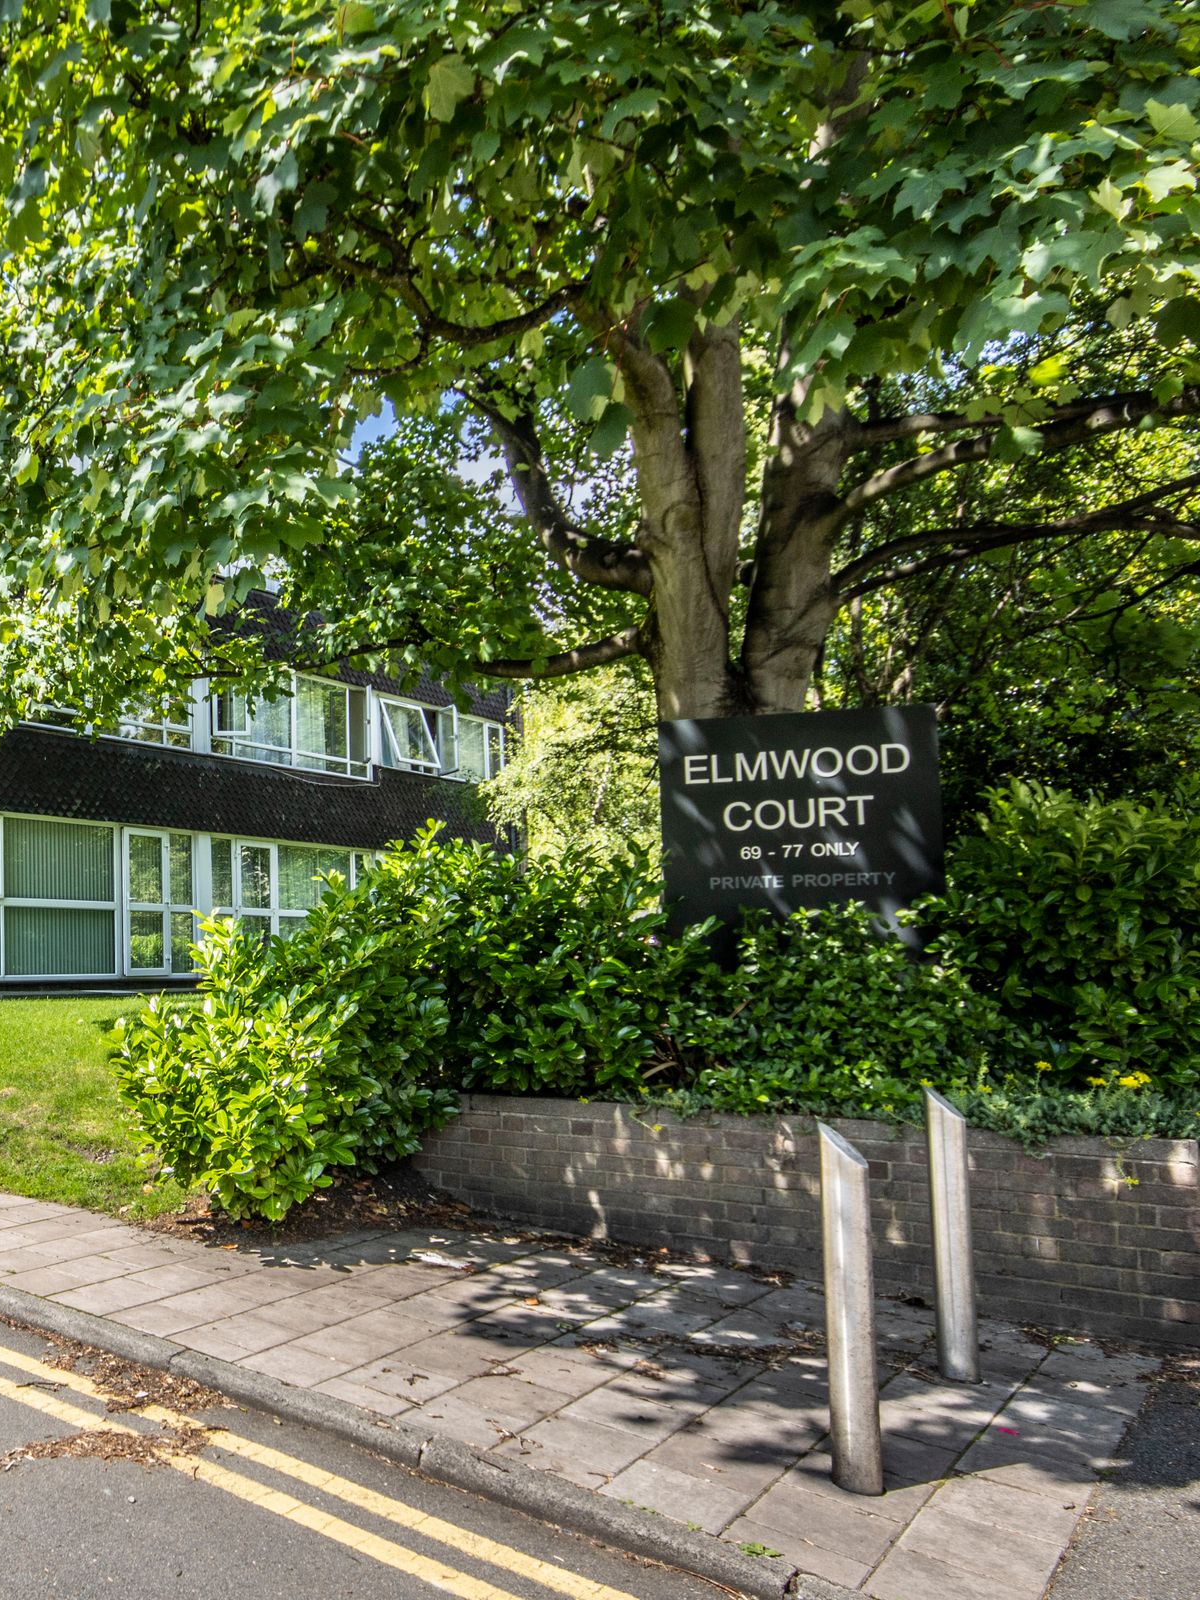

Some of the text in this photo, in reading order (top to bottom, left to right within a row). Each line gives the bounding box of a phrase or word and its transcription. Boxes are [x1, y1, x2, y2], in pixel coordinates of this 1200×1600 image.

[683, 743, 911, 785] ELMWOOD
[723, 795, 874, 832] COURT
[740, 846, 762, 859] 69
[782, 844, 803, 858] 77
[811, 841, 860, 857] ONLY
[710, 872, 896, 890] PRIVATE PROPERTY
